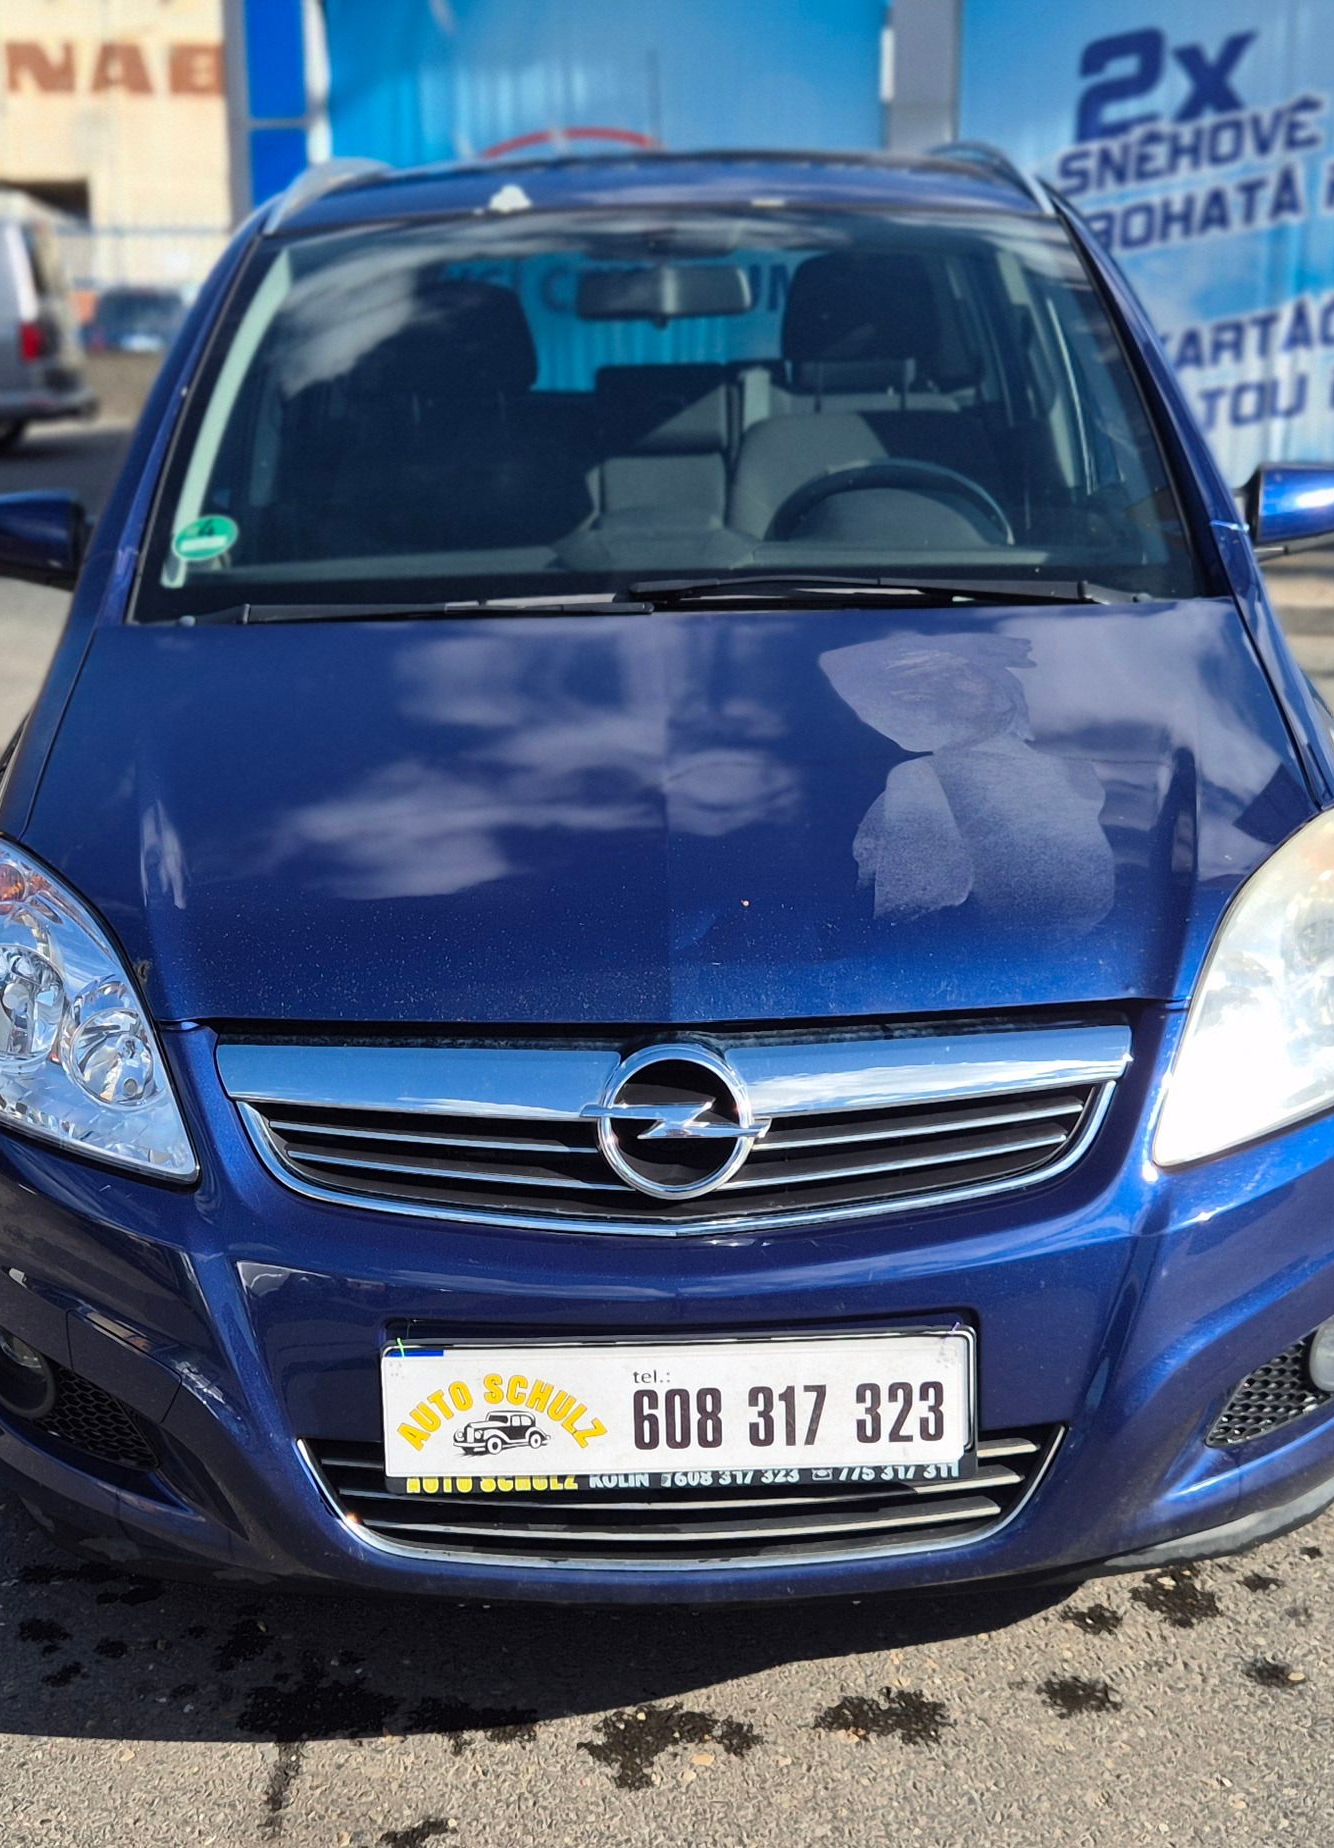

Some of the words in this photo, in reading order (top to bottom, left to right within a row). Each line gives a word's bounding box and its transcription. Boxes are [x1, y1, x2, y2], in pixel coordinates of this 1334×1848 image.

[633, 1370, 671, 1384] tel.:
[397, 1381, 474, 1452] AUTO
[483, 1373, 608, 1449] SCHULZ
[633, 1387, 723, 1450] 608
[748, 1384, 827, 1447] 317
[855, 1381, 945, 1443] 323
